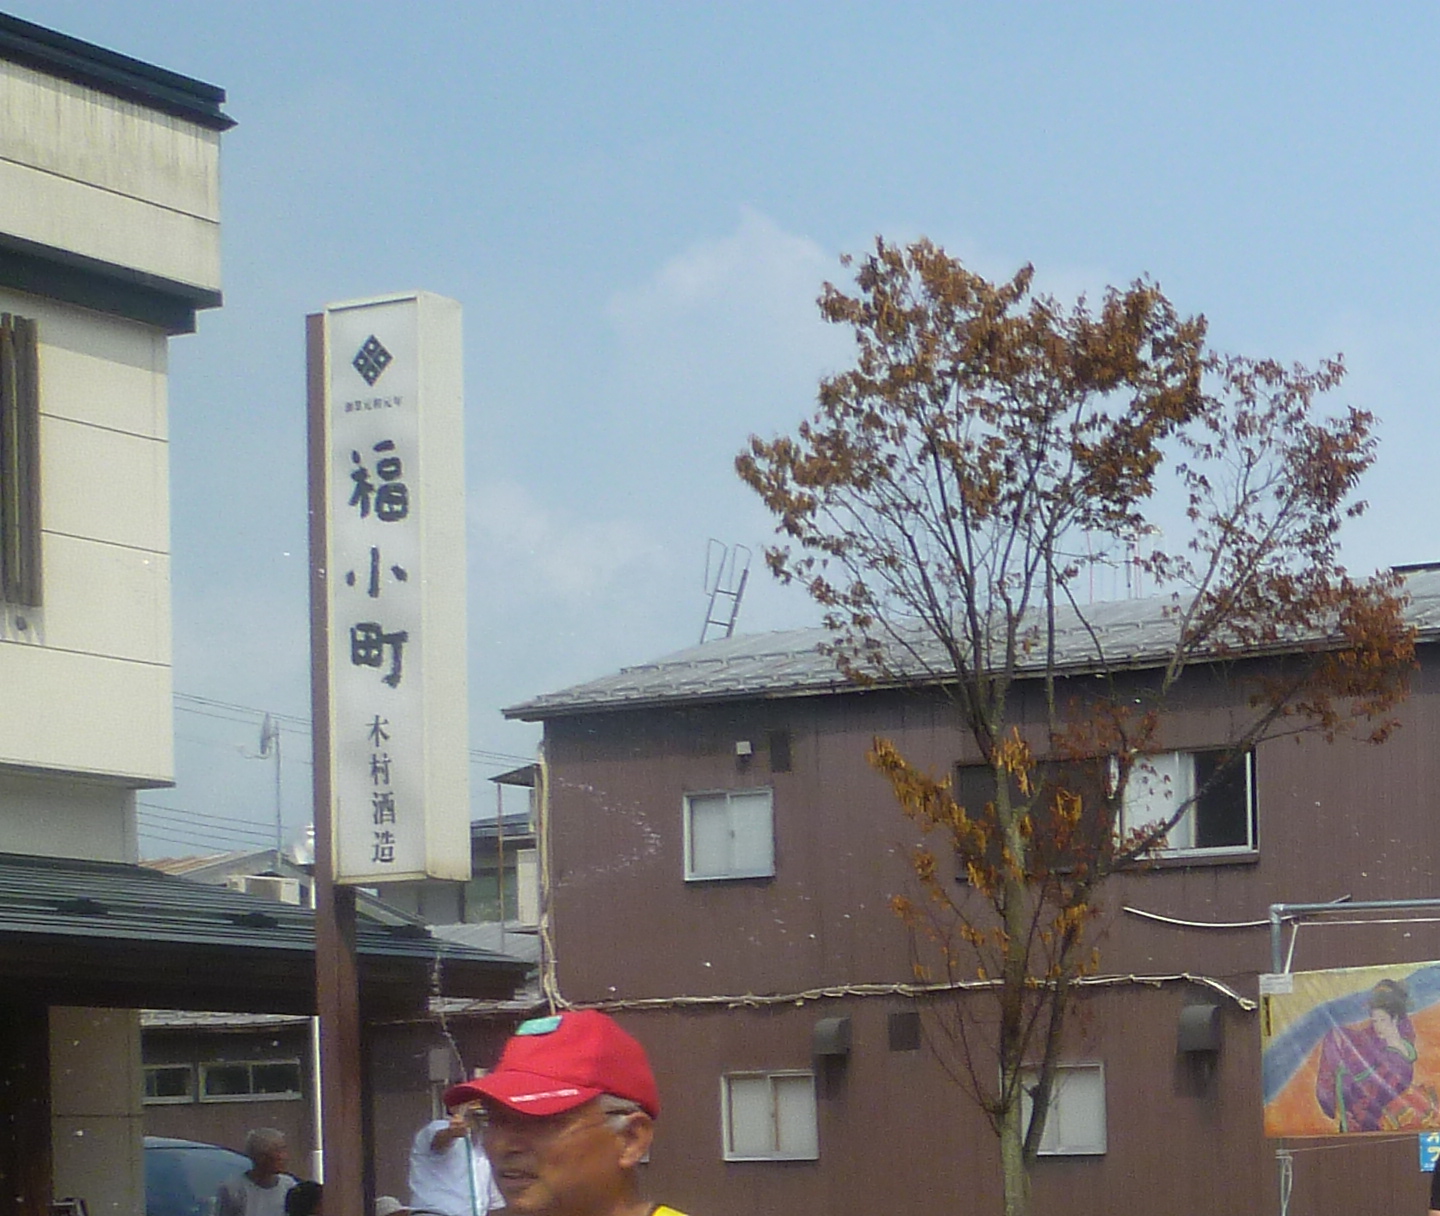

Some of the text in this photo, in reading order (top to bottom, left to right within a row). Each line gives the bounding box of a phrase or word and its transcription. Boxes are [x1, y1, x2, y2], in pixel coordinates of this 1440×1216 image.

[345, 440, 411, 688] 福小町
[365, 714, 397, 864] 木村酒造
